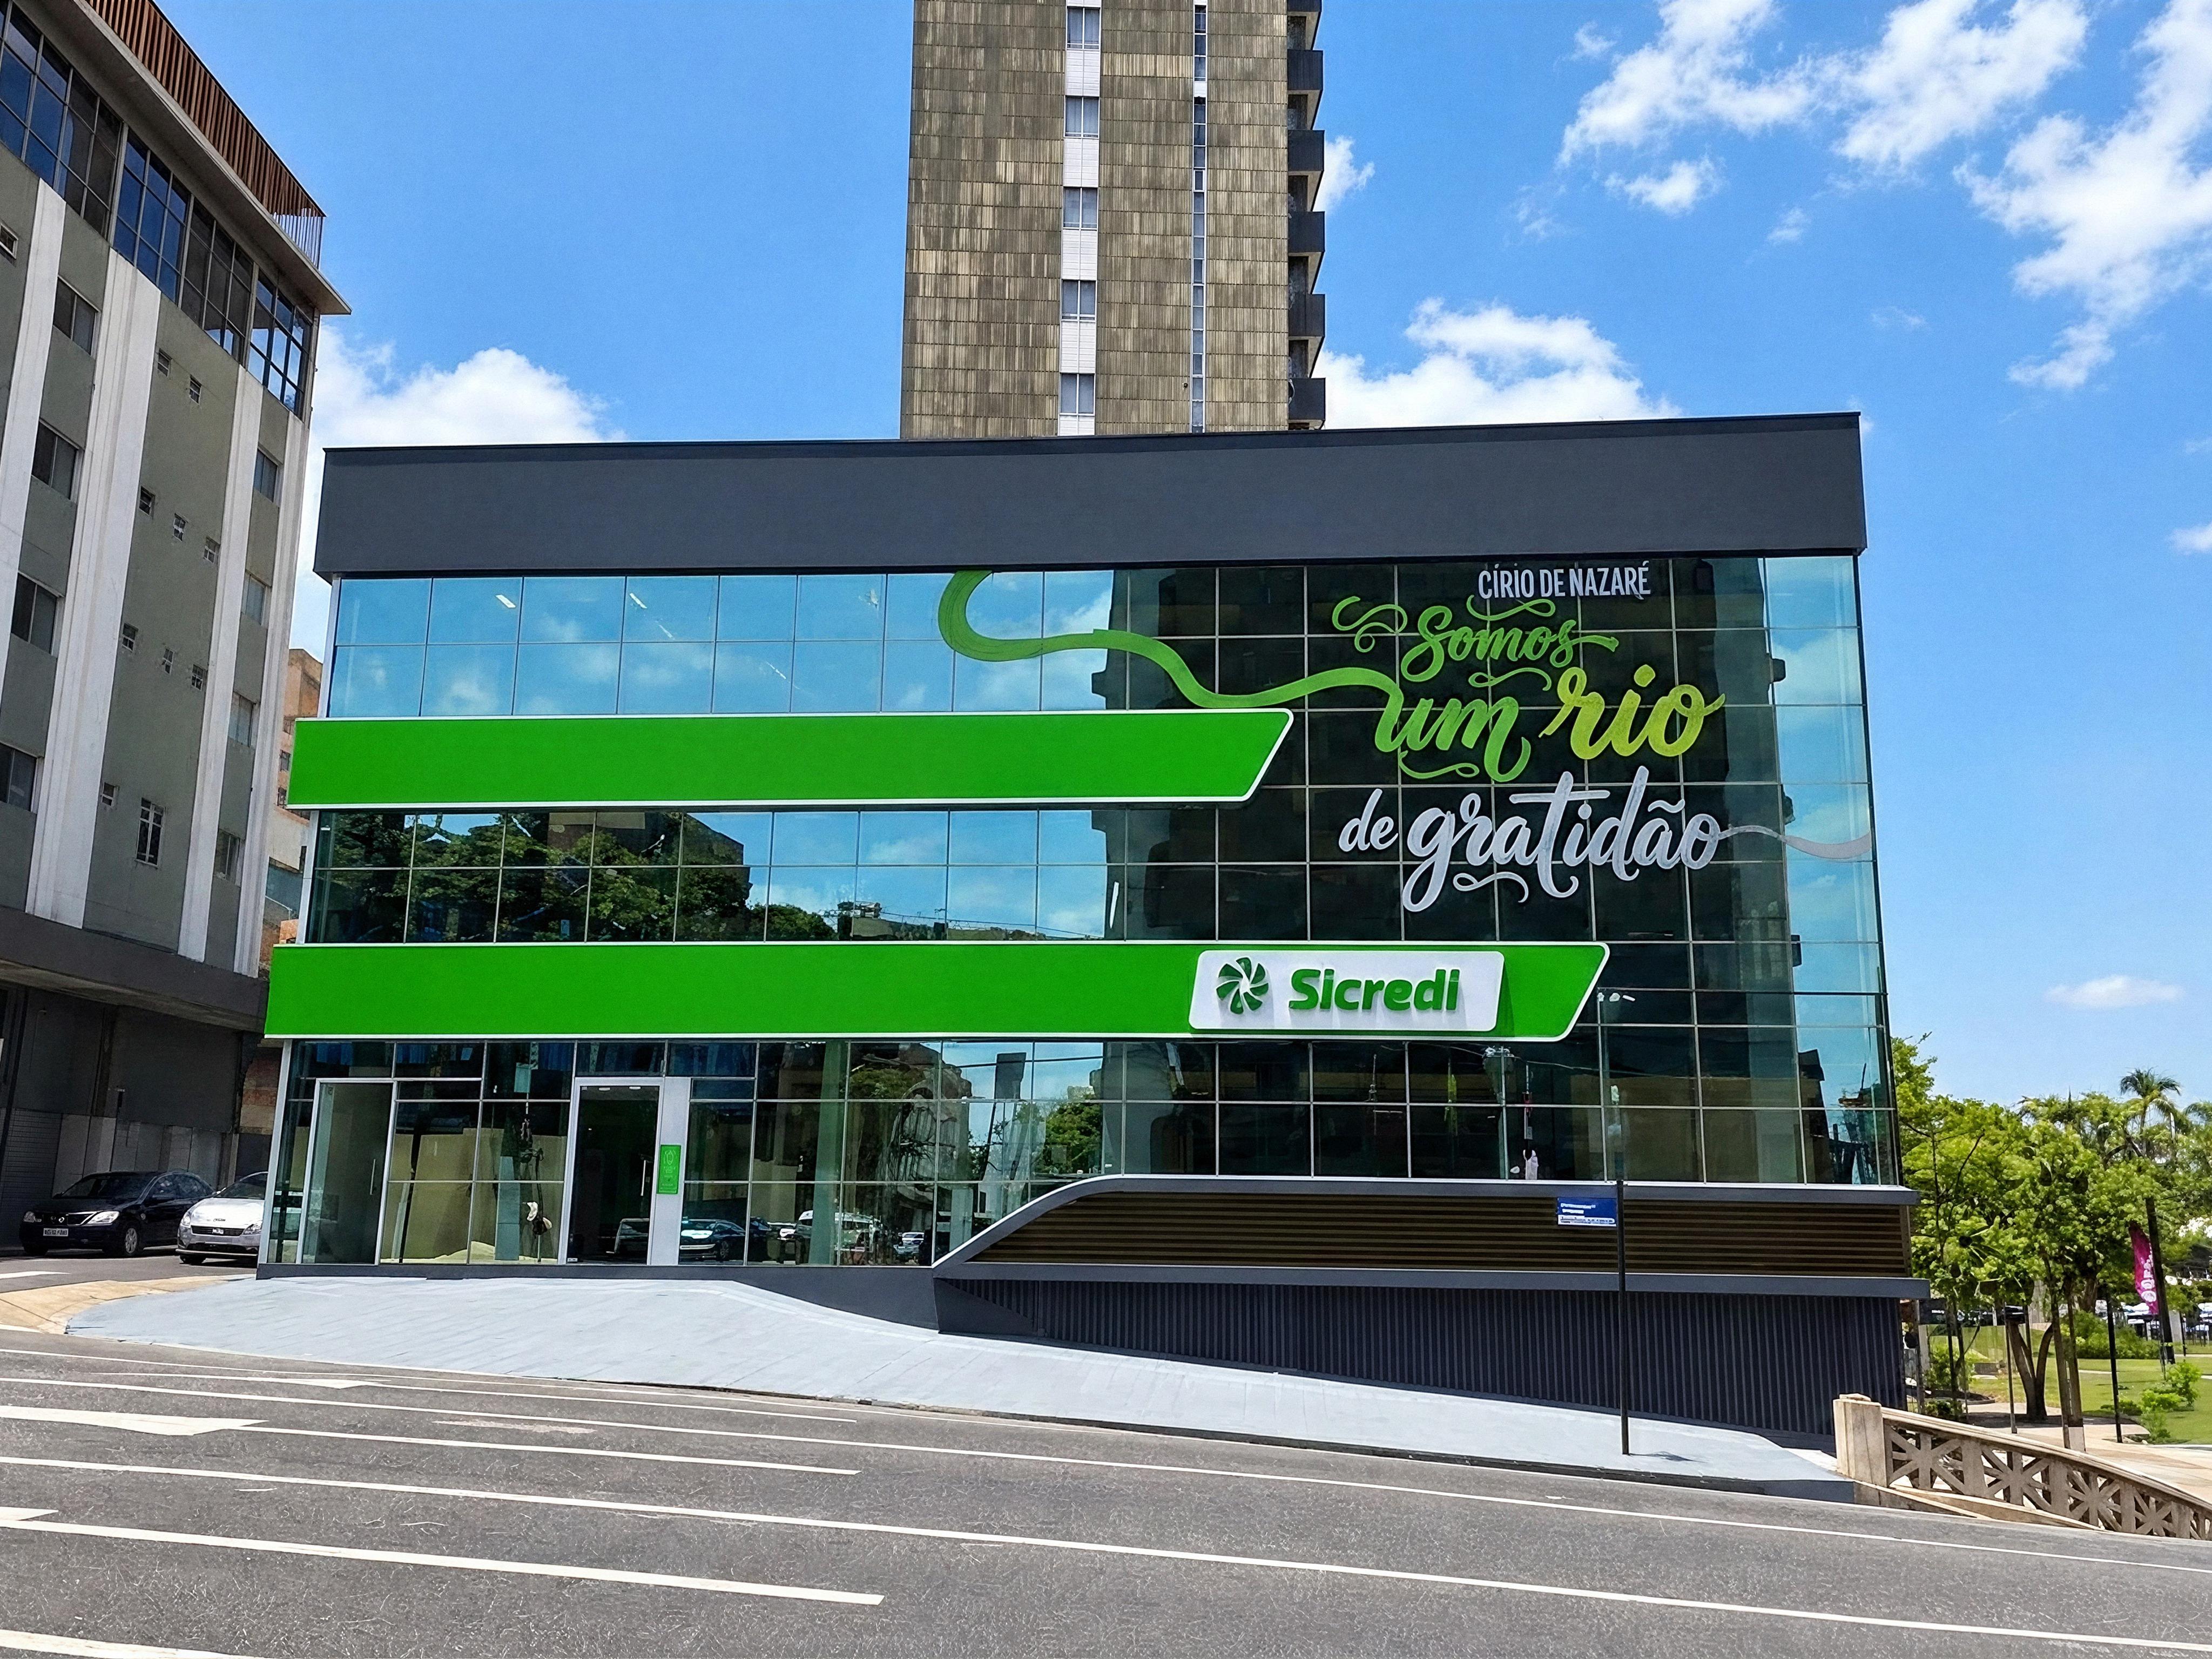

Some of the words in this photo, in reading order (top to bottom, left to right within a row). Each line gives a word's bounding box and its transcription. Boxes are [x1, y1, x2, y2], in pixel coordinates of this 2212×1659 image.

[1478, 563, 1534, 599] CÍRIO
[1539, 569, 1566, 597] DE
[1569, 561, 1651, 601] NAZARÉ
[1400, 605, 1619, 683] Somos
[1374, 672, 1530, 783] um
[1539, 664, 1725, 760] rio
[1338, 788, 1398, 852] de
[1401, 765, 1722, 913] gratidão
[1289, 968, 1460, 1011] Sicredi
